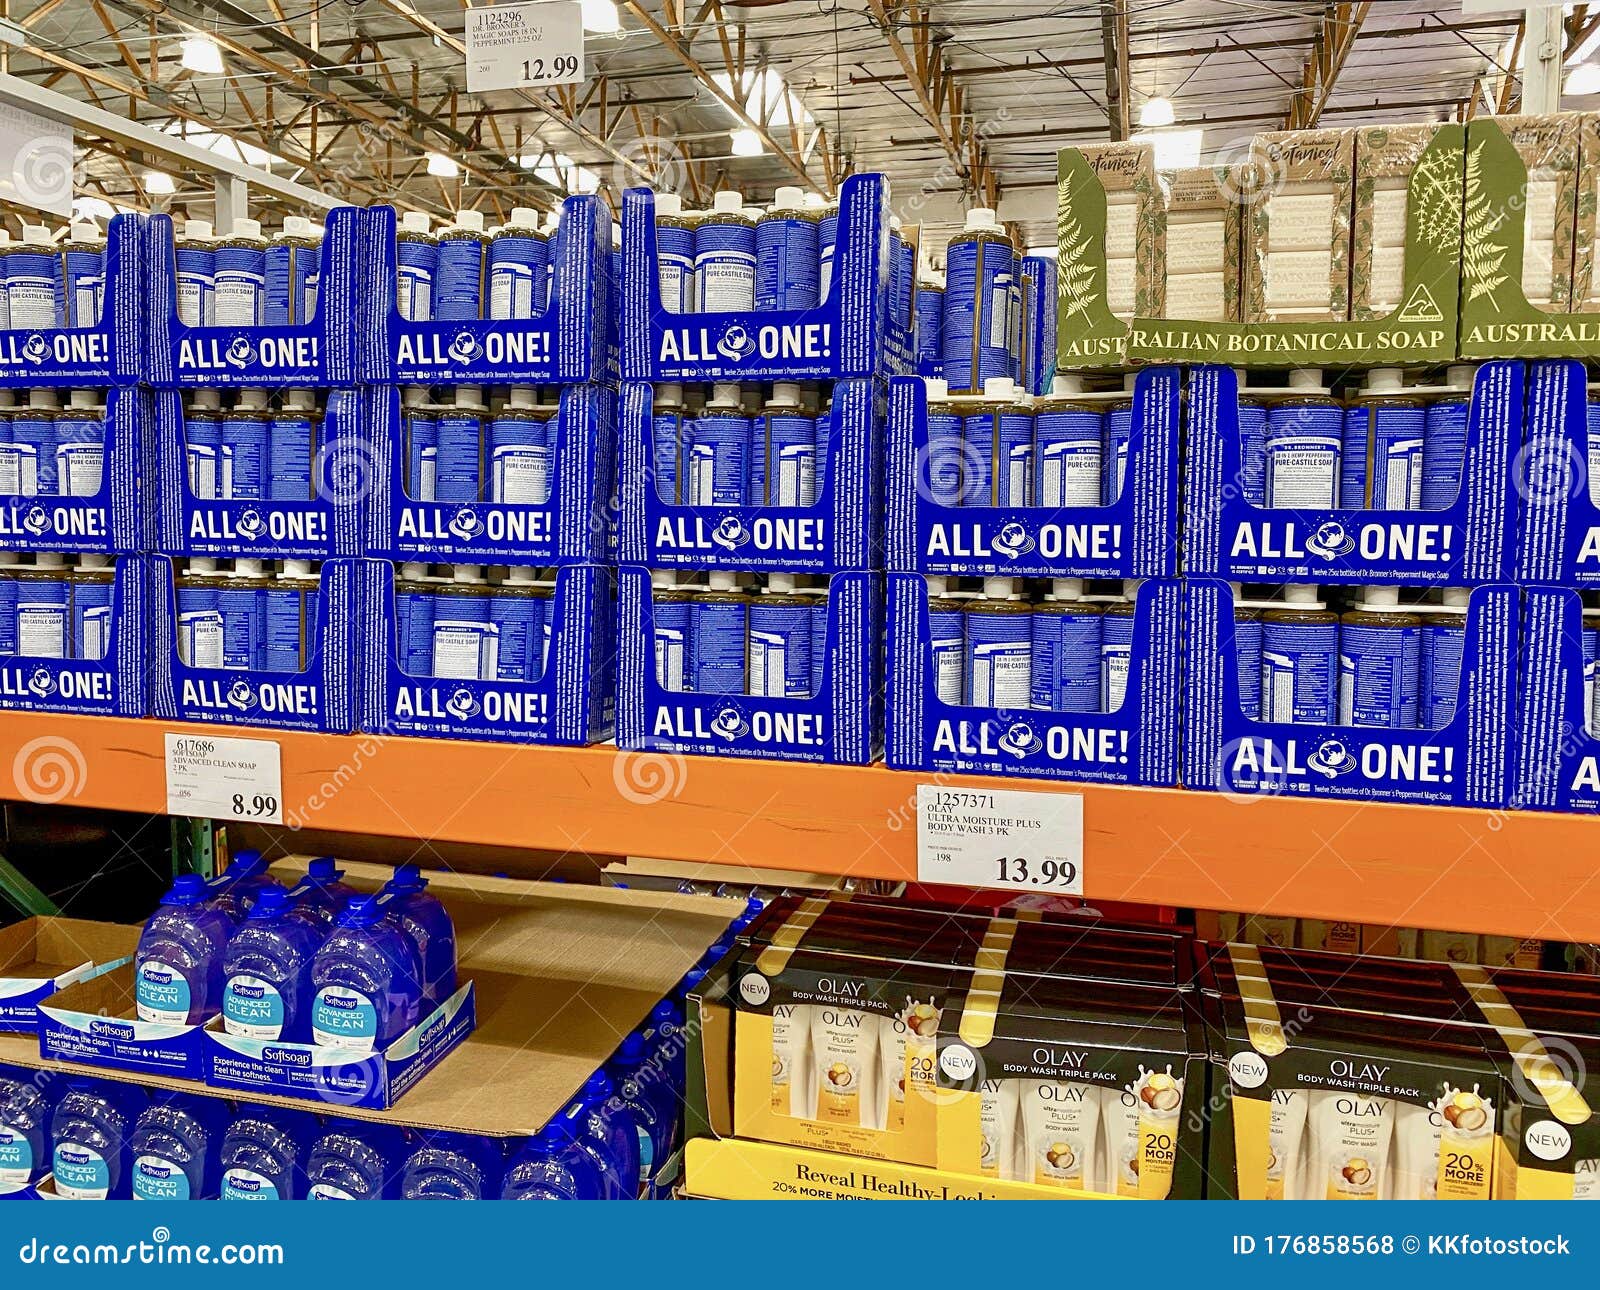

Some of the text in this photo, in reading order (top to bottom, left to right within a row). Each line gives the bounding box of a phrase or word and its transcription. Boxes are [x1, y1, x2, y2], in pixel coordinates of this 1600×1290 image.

[478, 11, 522, 26] 1124296
[472, 31, 497, 40] MAGIC
[498, 29, 519, 37] SOAPS
[530, 27, 538, 35] IN
[472, 38, 516, 48] PEPPERMINT
[522, 55, 579, 81] 12.99
[0, 334, 108, 363] LL ONE!
[397, 332, 549, 364] ALL ONE!
[660, 324, 830, 361] ALL ONE!
[1227, 332, 1372, 352] BOTANICAL
[1376, 331, 1445, 350] SOAP
[179, 338, 318, 368] ALL ONE!
[0, 507, 106, 536] LL ONE!
[191, 511, 327, 540] ALL ONE!
[399, 509, 551, 541] ALL ONE!
[656, 517, 823, 550] ALL ONE!
[927, 524, 1121, 558] ALL ONE!
[1231, 522, 1452, 561] ALL ONE!
[60, 671, 112, 699] ONE!
[183, 680, 317, 714] ALL ONE!
[396, 687, 547, 723] ALL ONE!
[654, 707, 823, 745] ALL ONE!
[177, 739, 215, 753] 617686
[934, 720, 1128, 763] ALL ONE!
[173, 758, 212, 766] ADVANCED
[213, 761, 237, 769] CLEAN
[1233, 738, 1453, 782] ALL ONE!
[232, 794, 278, 817] 8.99
[927, 804, 954, 814] OLAY
[936, 792, 995, 809] 1257371
[927, 813, 1041, 829] ULTRA MOISTURE PLUS
[927, 822, 954, 832] BODY
[958, 825, 985, 835] WASH
[988, 827, 993, 835] 3
[996, 828, 1009, 836] PK
[995, 856, 1077, 887] 13.99
[144, 970, 172, 984] Softsoap
[139, 988, 178, 1004] CLEAN
[140, 981, 178, 994] ADVANCED
[233, 984, 264, 998] Softsoap
[742, 982, 768, 995] NEW
[818, 978, 864, 997] OLAY
[227, 995, 270, 1008] ADVANCED
[324, 995, 357, 1008] Softsoap
[792, 991, 888, 1009] BODY WASH TRIPLE PACK
[227, 1003, 271, 1018] CLEAN
[319, 1007, 364, 1019] ADVANCED
[318, 1014, 364, 1029] CLEAN
[822, 1011, 865, 1028] OLAY
[46, 1029, 111, 1047] Experience the clean.
[92, 1022, 132, 1039] Softsoap
[47, 1038, 60, 1047] Feel
[72, 1042, 100, 1054] softness.
[265, 1048, 310, 1065] Softsoap
[943, 1056, 974, 1069] NEW
[1033, 1048, 1088, 1068] OLAY
[213, 1056, 285, 1075] Experience the clean.
[214, 1065, 272, 1082] Feel the softness.
[1003, 1063, 1117, 1081] BODY WASH TRIPLE PACK
[1231, 1063, 1266, 1077] NEW
[1330, 1060, 1390, 1081] OLAY
[1038, 1084, 1089, 1102] OLAY
[1297, 1073, 1420, 1097] BODY WASH TRIPLE PACK
[1336, 1098, 1387, 1117] OLAY
[1529, 1132, 1568, 1148] NEW
[61, 1151, 89, 1163] Softsoap
[1145, 1149, 1173, 1160] MOR
[1446, 1153, 1484, 1173] 20%
[57, 1161, 96, 1175] ADVANCED
[57, 1168, 96, 1182] CLEAN
[141, 1164, 170, 1177] Softsoap
[796, 1163, 855, 1188] Reveal
[1445, 1168, 1484, 1182] MORE
[136, 1176, 177, 1188] ADVANCED
[136, 1182, 177, 1197] CLEAN
[230, 1177, 260, 1191] Softsoap
[772, 1181, 833, 1199] 20% MORE
